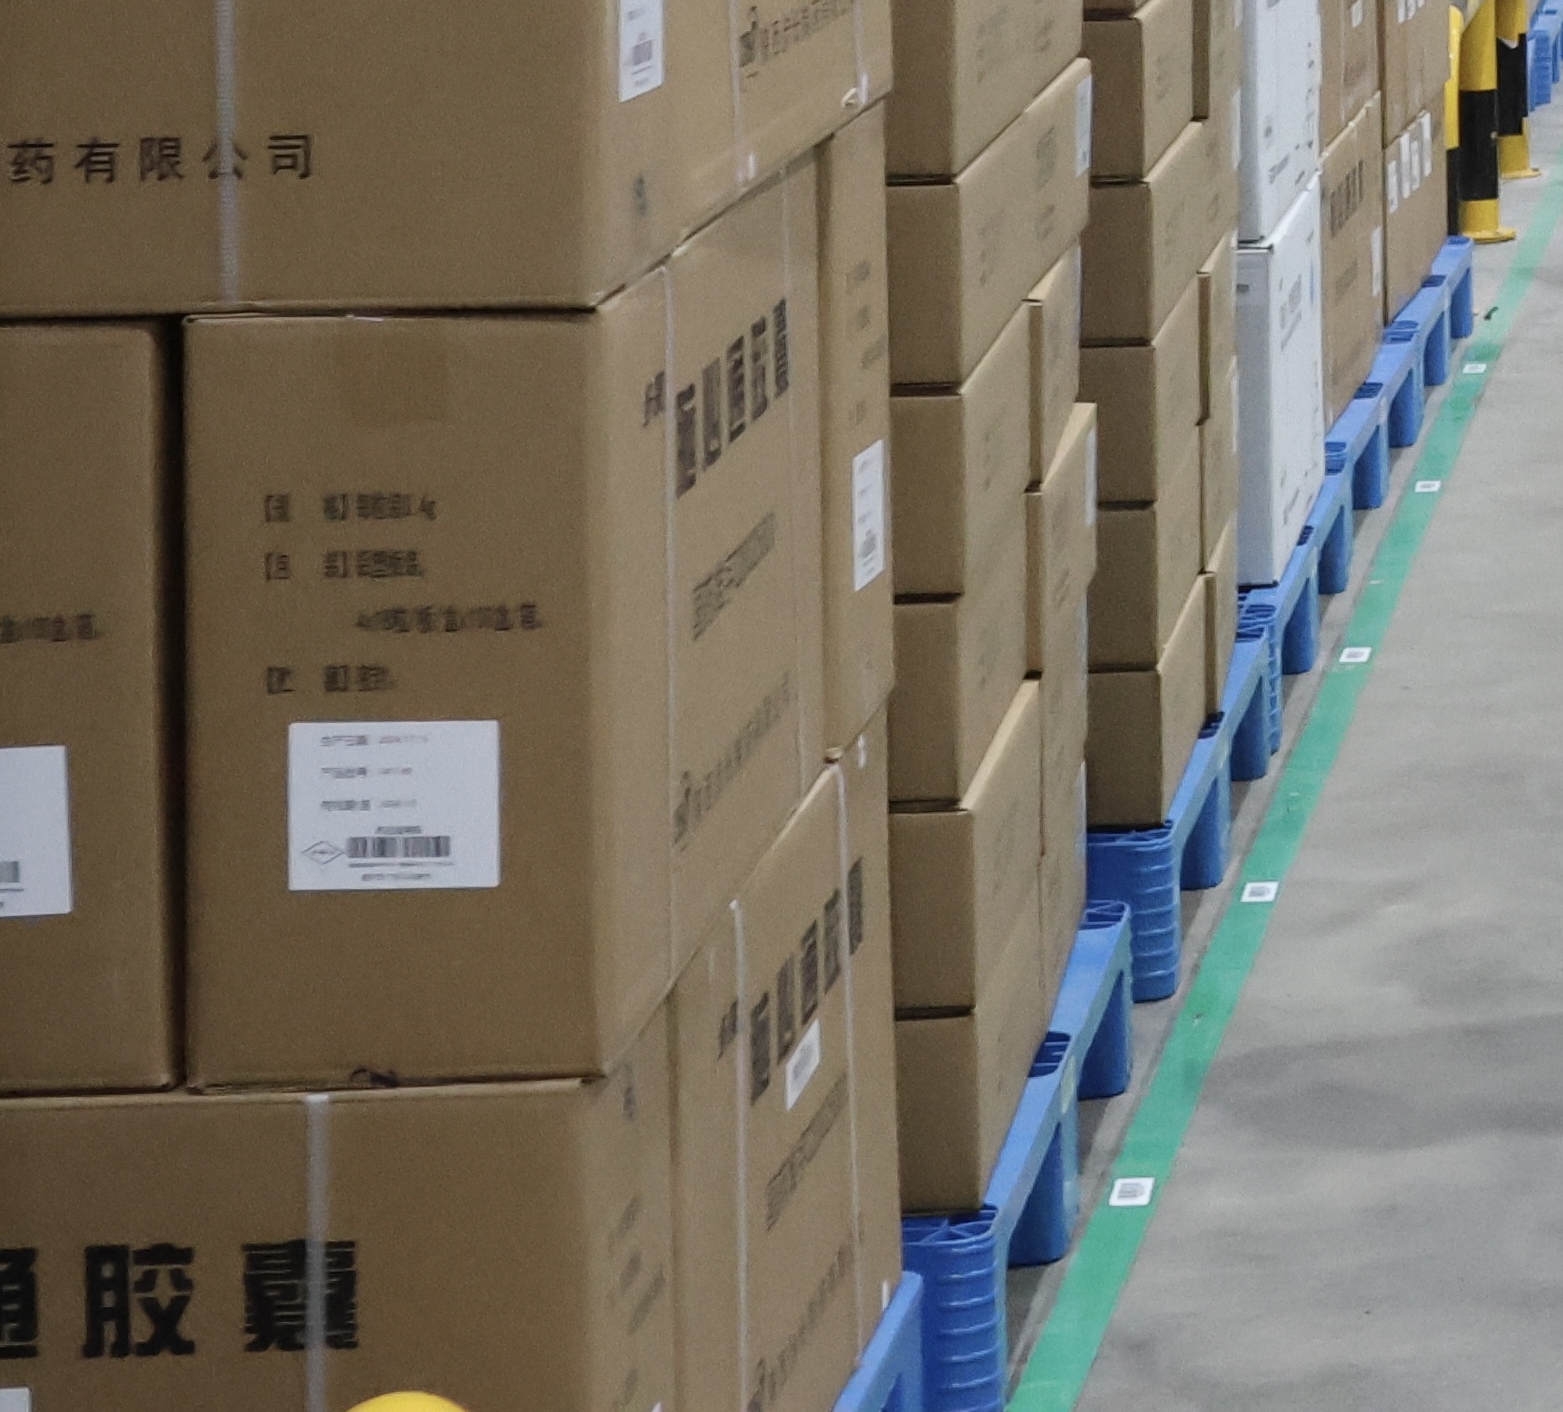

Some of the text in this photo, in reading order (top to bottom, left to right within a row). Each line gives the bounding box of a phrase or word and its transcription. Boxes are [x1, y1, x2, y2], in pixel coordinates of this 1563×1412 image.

[8, 134, 313, 184] 药有限公司
